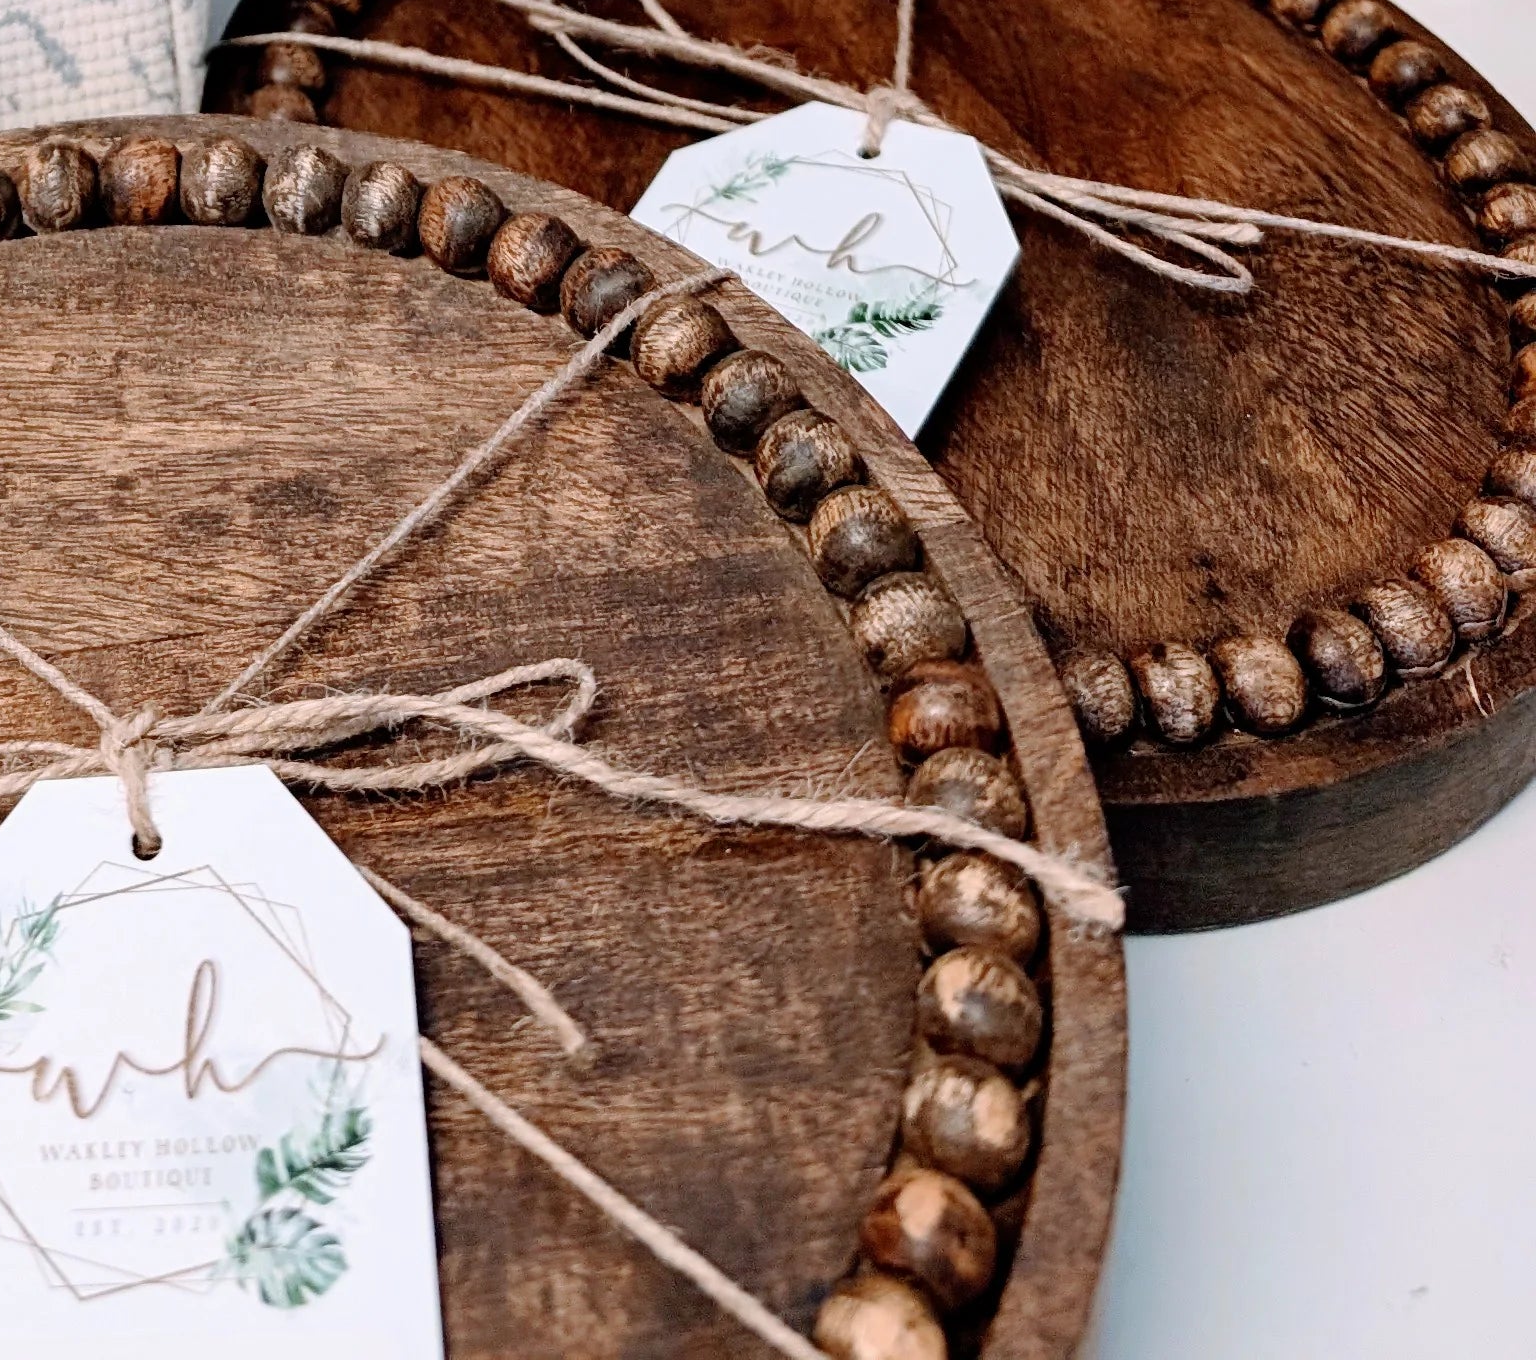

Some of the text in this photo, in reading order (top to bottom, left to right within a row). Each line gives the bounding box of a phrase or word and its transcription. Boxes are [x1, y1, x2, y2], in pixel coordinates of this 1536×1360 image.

[39, 1132, 260, 1162] WAKLEY HOLLOW
[88, 1165, 213, 1191] BOUTIQUE
